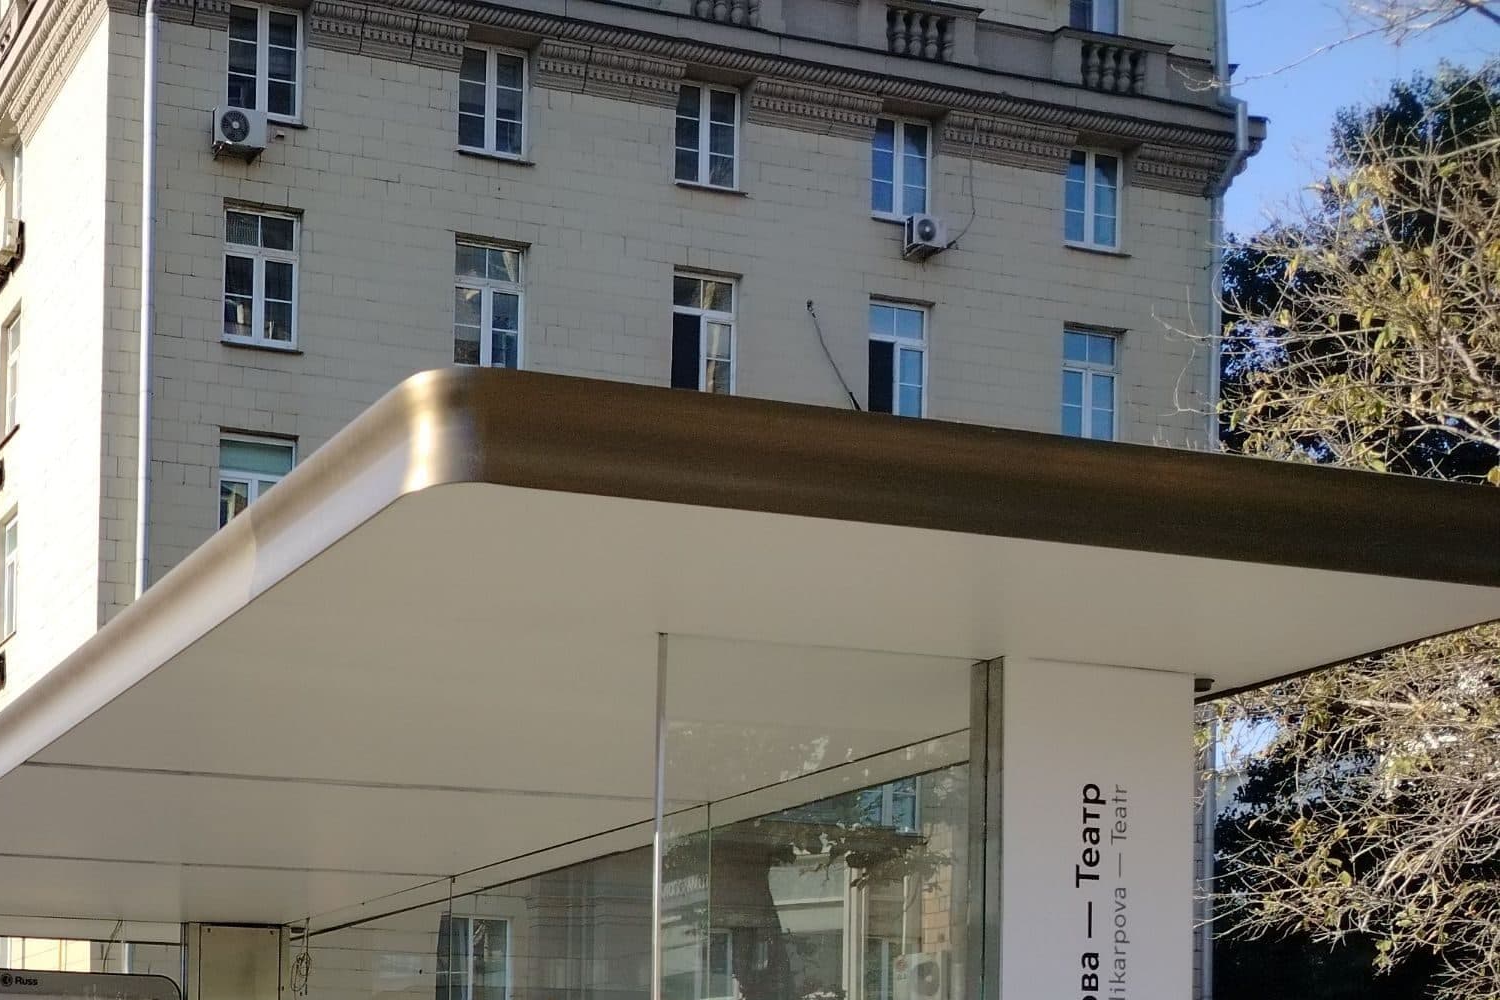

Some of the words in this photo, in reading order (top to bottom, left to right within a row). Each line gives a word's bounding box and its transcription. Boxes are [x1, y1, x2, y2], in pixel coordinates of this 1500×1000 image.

[1075, 782, 1107, 889] Театр
[1110, 783, 1128, 845] Teatr
[14, 976, 39, 986] Russ
